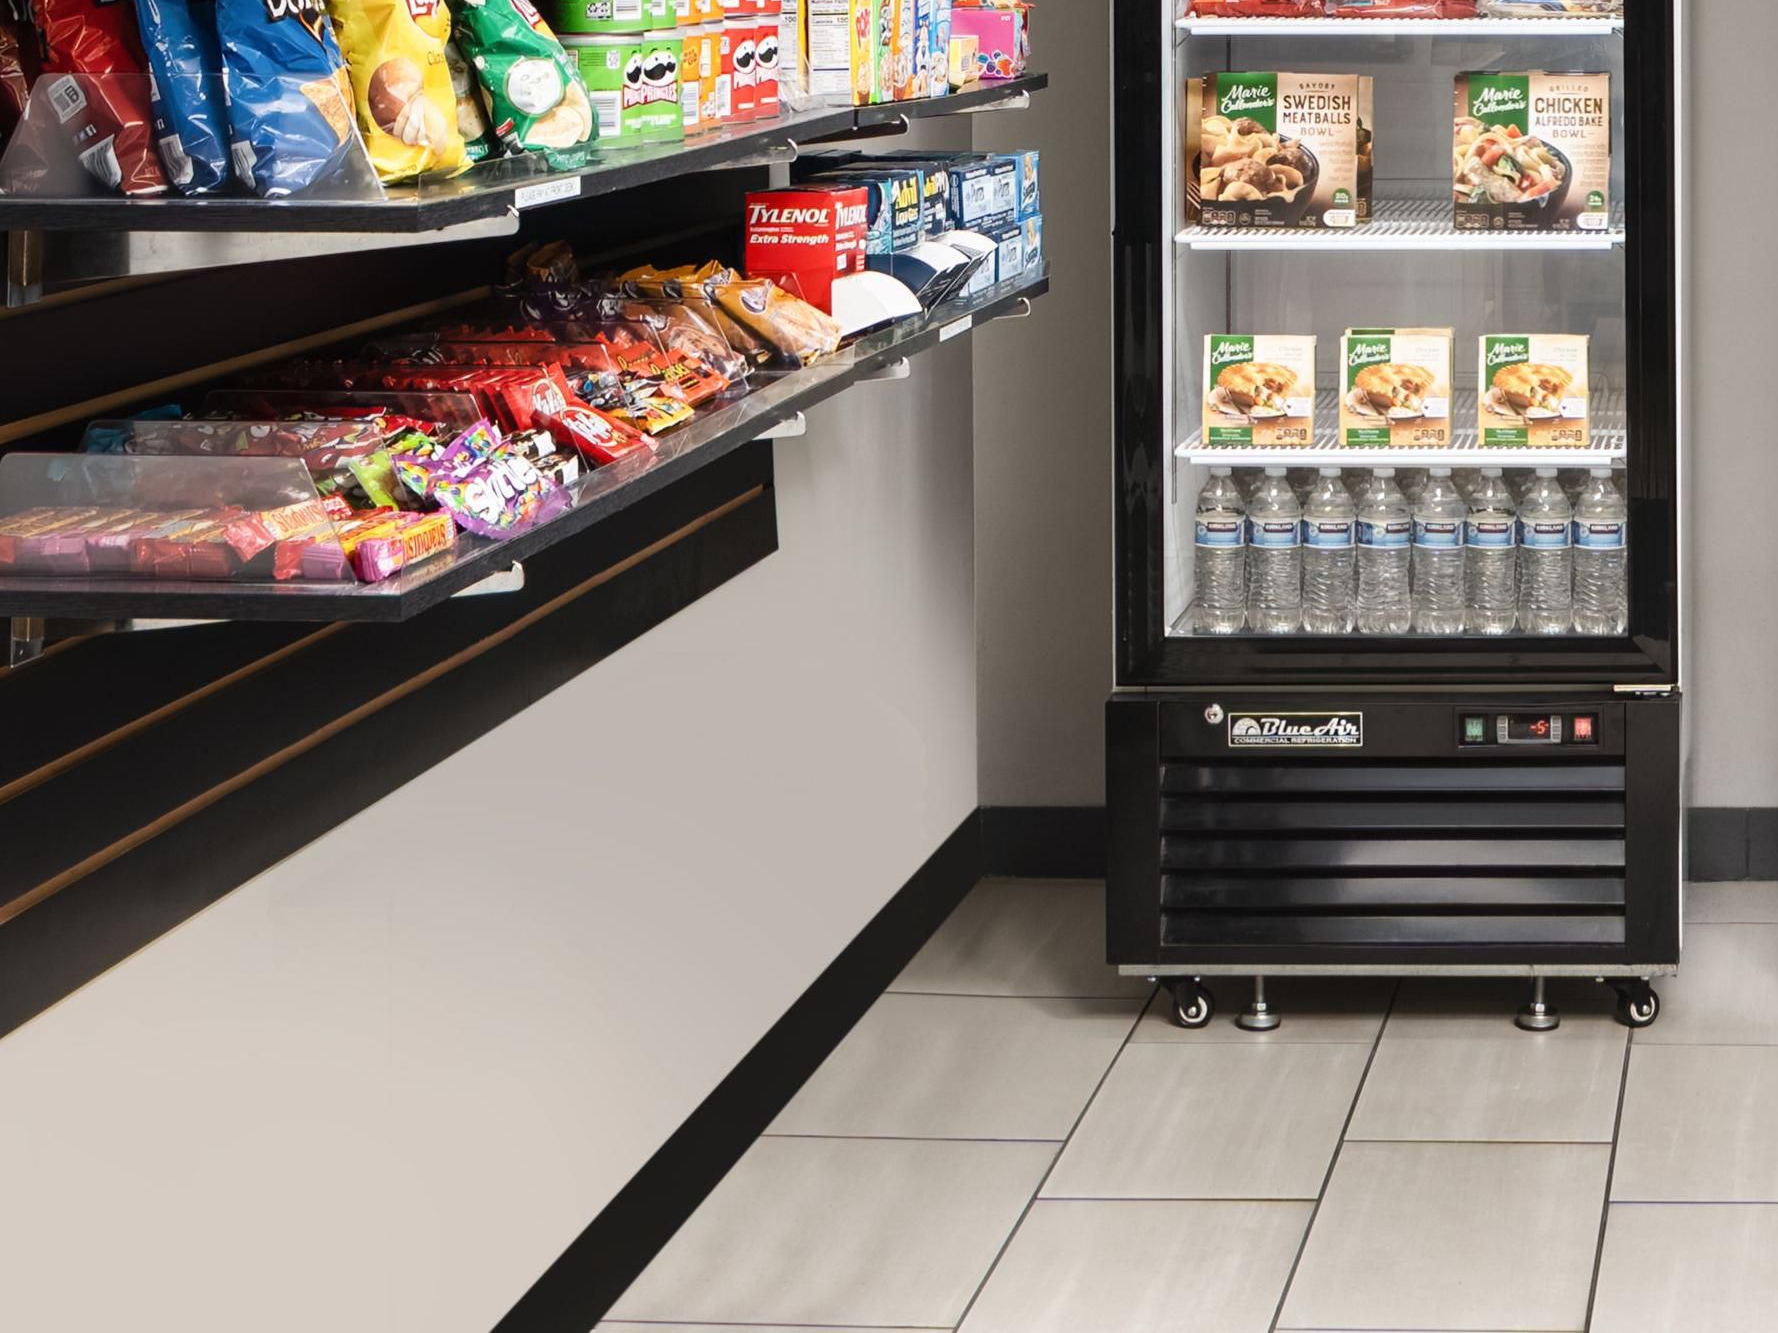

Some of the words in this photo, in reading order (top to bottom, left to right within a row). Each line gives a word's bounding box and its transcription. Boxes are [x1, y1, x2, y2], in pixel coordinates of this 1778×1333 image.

[1222, 85, 1271, 103] Marie
[1474, 87, 1524, 105] Marie
[1221, 98, 1275, 114] Callender's
[1283, 95, 1351, 111] SWEDISH
[1473, 100, 1527, 117] Callender's
[1535, 97, 1603, 114] CHICKEN
[1283, 112, 1352, 125] MEATBALLS
[1535, 116, 1577, 127] ALFREDO
[1579, 116, 1604, 127] BAKE
[1301, 128, 1335, 137] BOWL
[1552, 129, 1587, 139] BOWL
[749, 205, 830, 225] TYLENOL
[750, 234, 779, 245] Extra
[782, 233, 830, 246] Strength
[1213, 341, 1252, 356] Marie
[1350, 343, 1388, 357] Marie
[1487, 343, 1526, 357] Marie
[1291, 736, 1358, 744] REFRIGERATION
